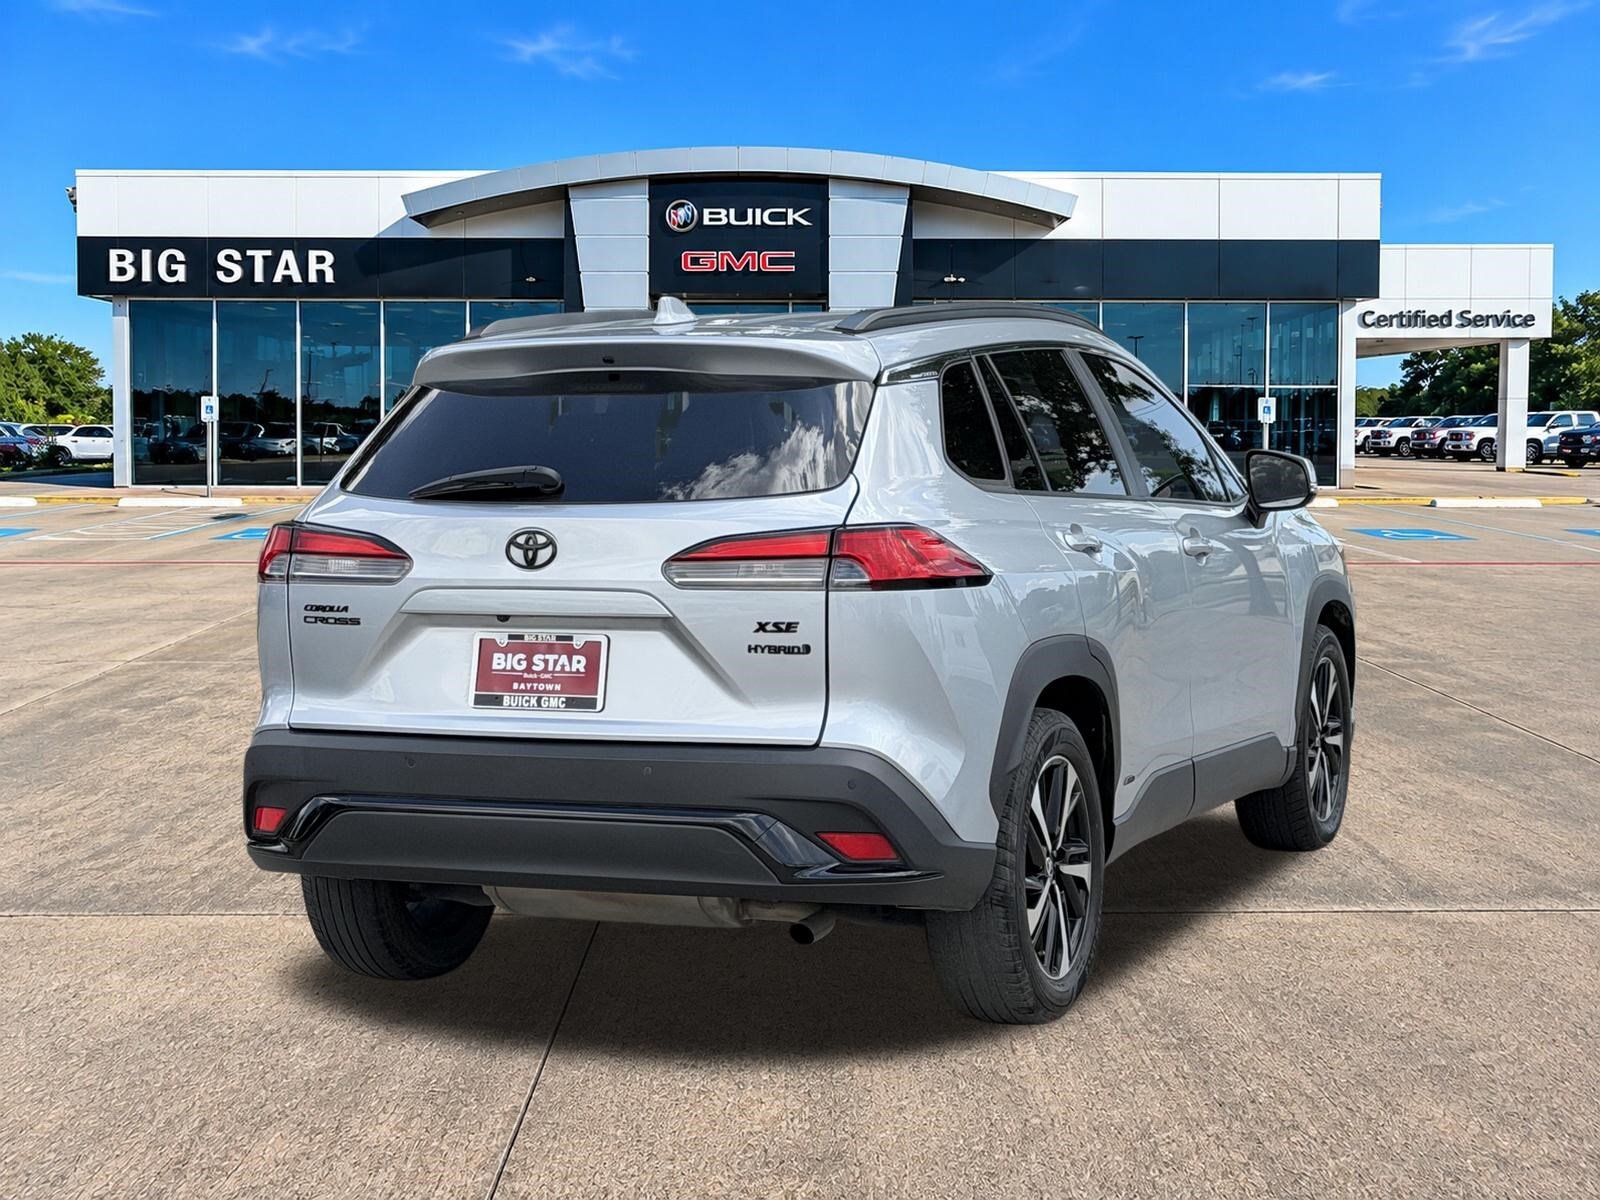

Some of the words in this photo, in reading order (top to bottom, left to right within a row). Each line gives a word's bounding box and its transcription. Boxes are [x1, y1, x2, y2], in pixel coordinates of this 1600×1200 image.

[703, 208, 812, 226] BUICK
[108, 248, 187, 283] BIG
[215, 248, 336, 284] STAR
[681, 251, 796, 272] GMC
[1359, 309, 1453, 329] Certified
[1455, 309, 1536, 328] Service
[304, 604, 349, 613] COROLLA
[303, 616, 361, 626] CROSS
[752, 621, 800, 634] XSE
[523, 633, 537, 641] BIG
[491, 653, 528, 671] BIG
[531, 654, 587, 673] STAR
[512, 682, 561, 691] BAYTOWN
[502, 695, 538, 708] BUICK
[540, 697, 566, 708] GMC
